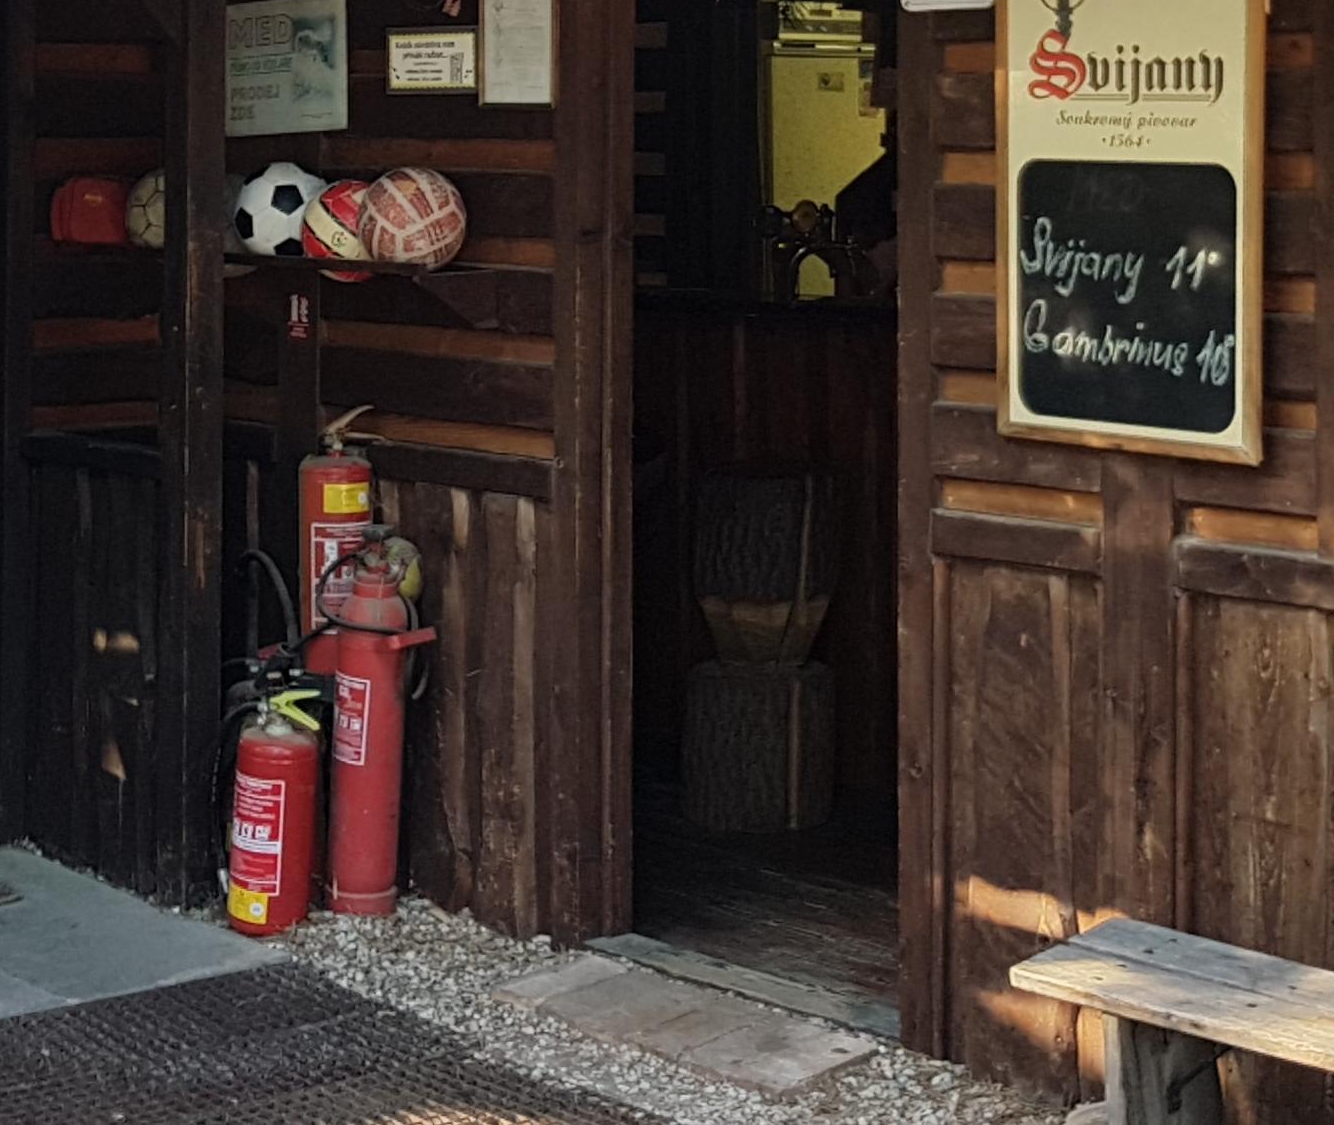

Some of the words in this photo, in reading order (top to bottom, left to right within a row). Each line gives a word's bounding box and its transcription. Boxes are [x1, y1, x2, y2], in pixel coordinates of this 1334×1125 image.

[1028, 29, 1224, 107] Svijany
[1019, 216, 1145, 305] Svijany
[1023, 298, 1189, 377] Gambrinus
